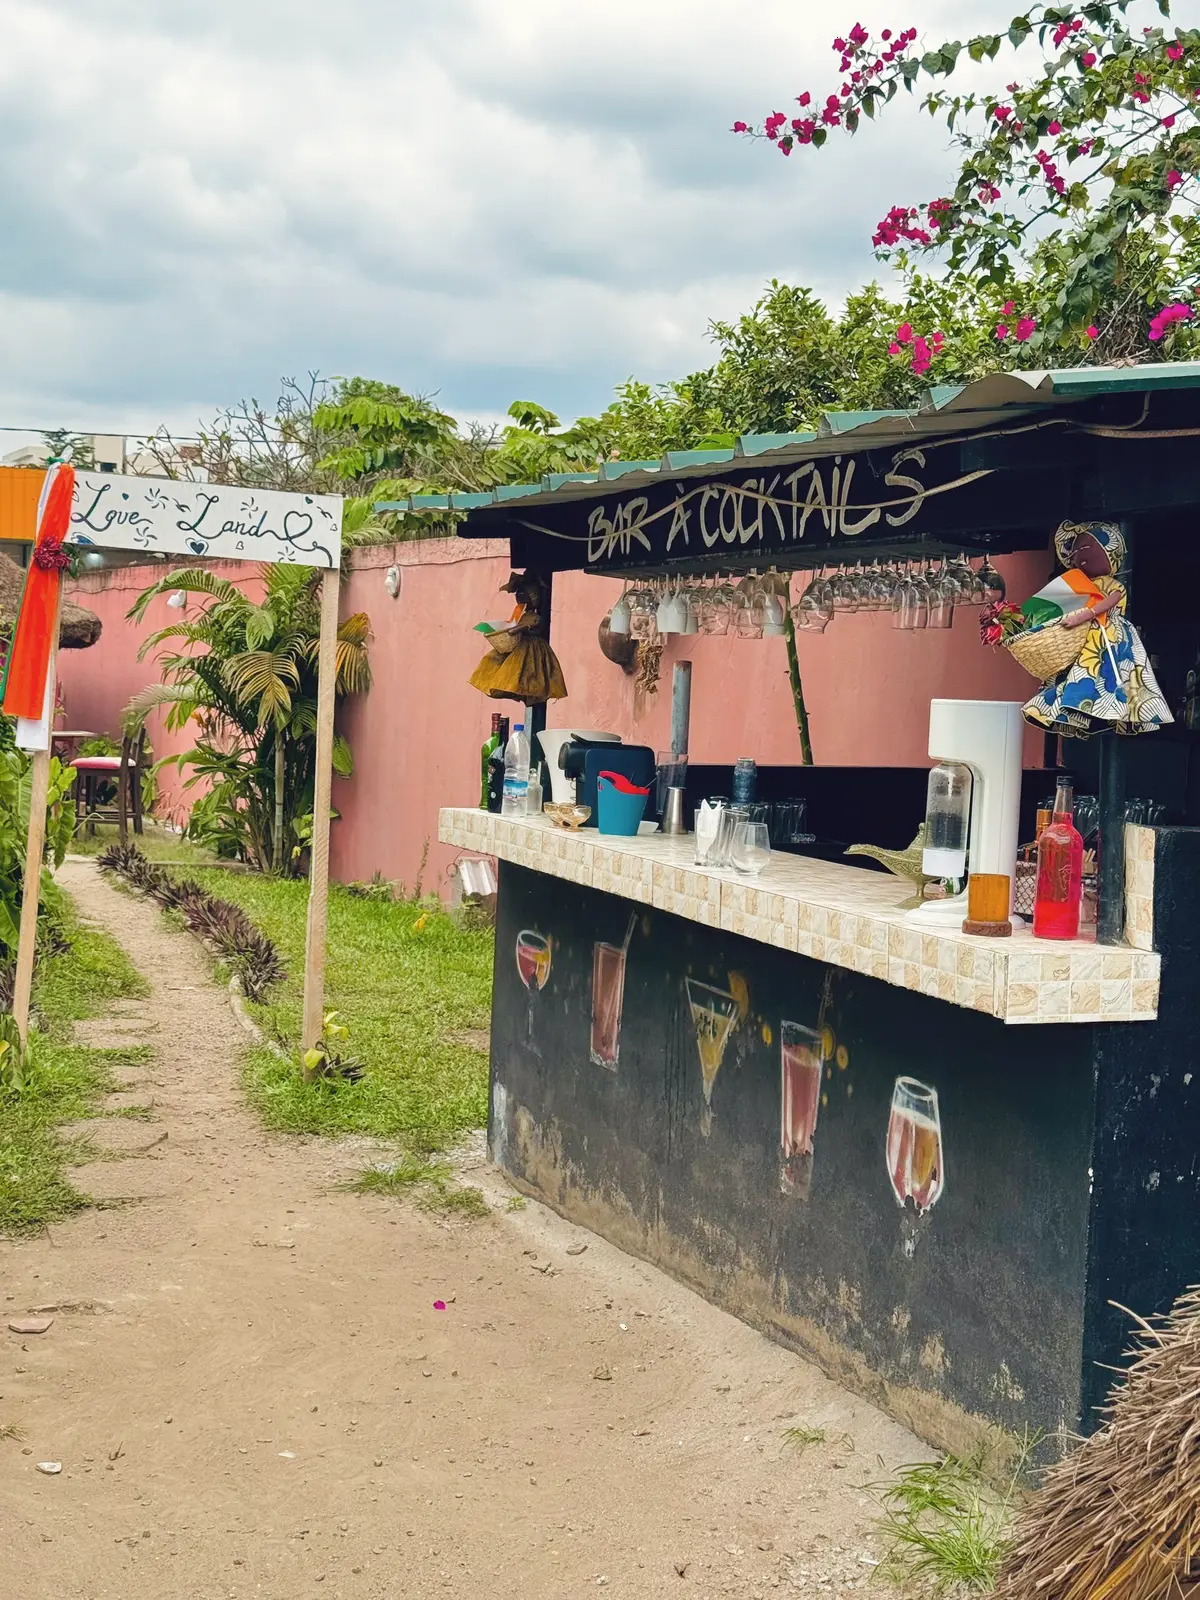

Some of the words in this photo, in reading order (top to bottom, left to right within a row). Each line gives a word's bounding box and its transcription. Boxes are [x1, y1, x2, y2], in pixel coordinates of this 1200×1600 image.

[70, 480, 153, 532] Love
[176, 492, 270, 540] Land
[587, 495, 652, 563] BAR
[665, 482, 693, 552] À
